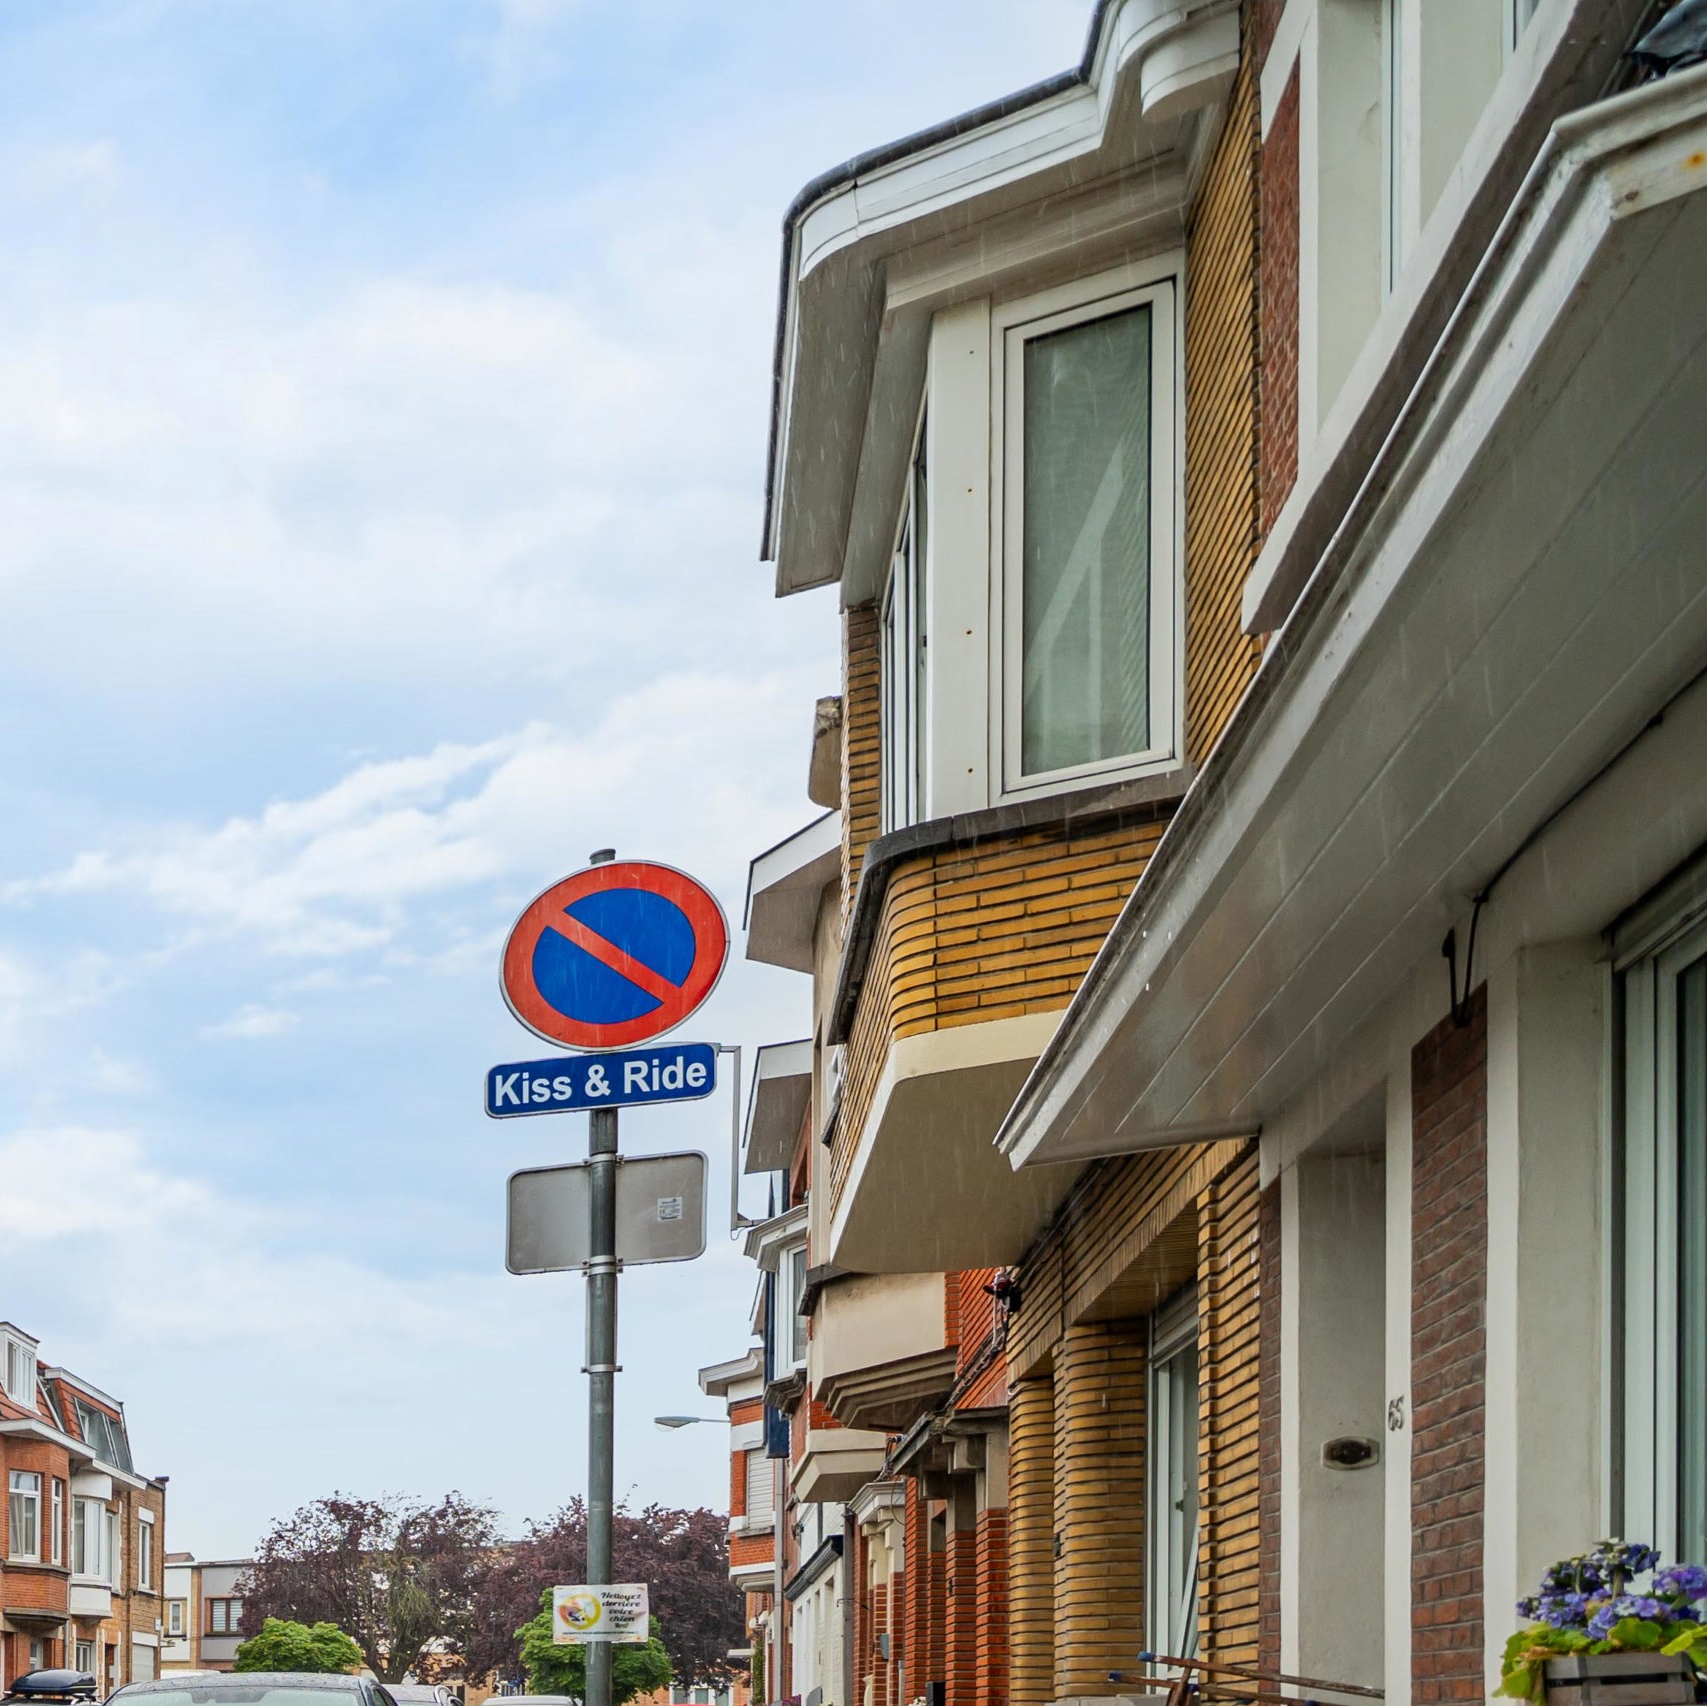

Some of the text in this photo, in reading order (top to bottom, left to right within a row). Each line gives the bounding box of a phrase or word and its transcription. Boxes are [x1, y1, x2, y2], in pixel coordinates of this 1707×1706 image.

[495, 1056, 707, 1107] Kiss & Ride
[1388, 1395, 1404, 1432] 65
